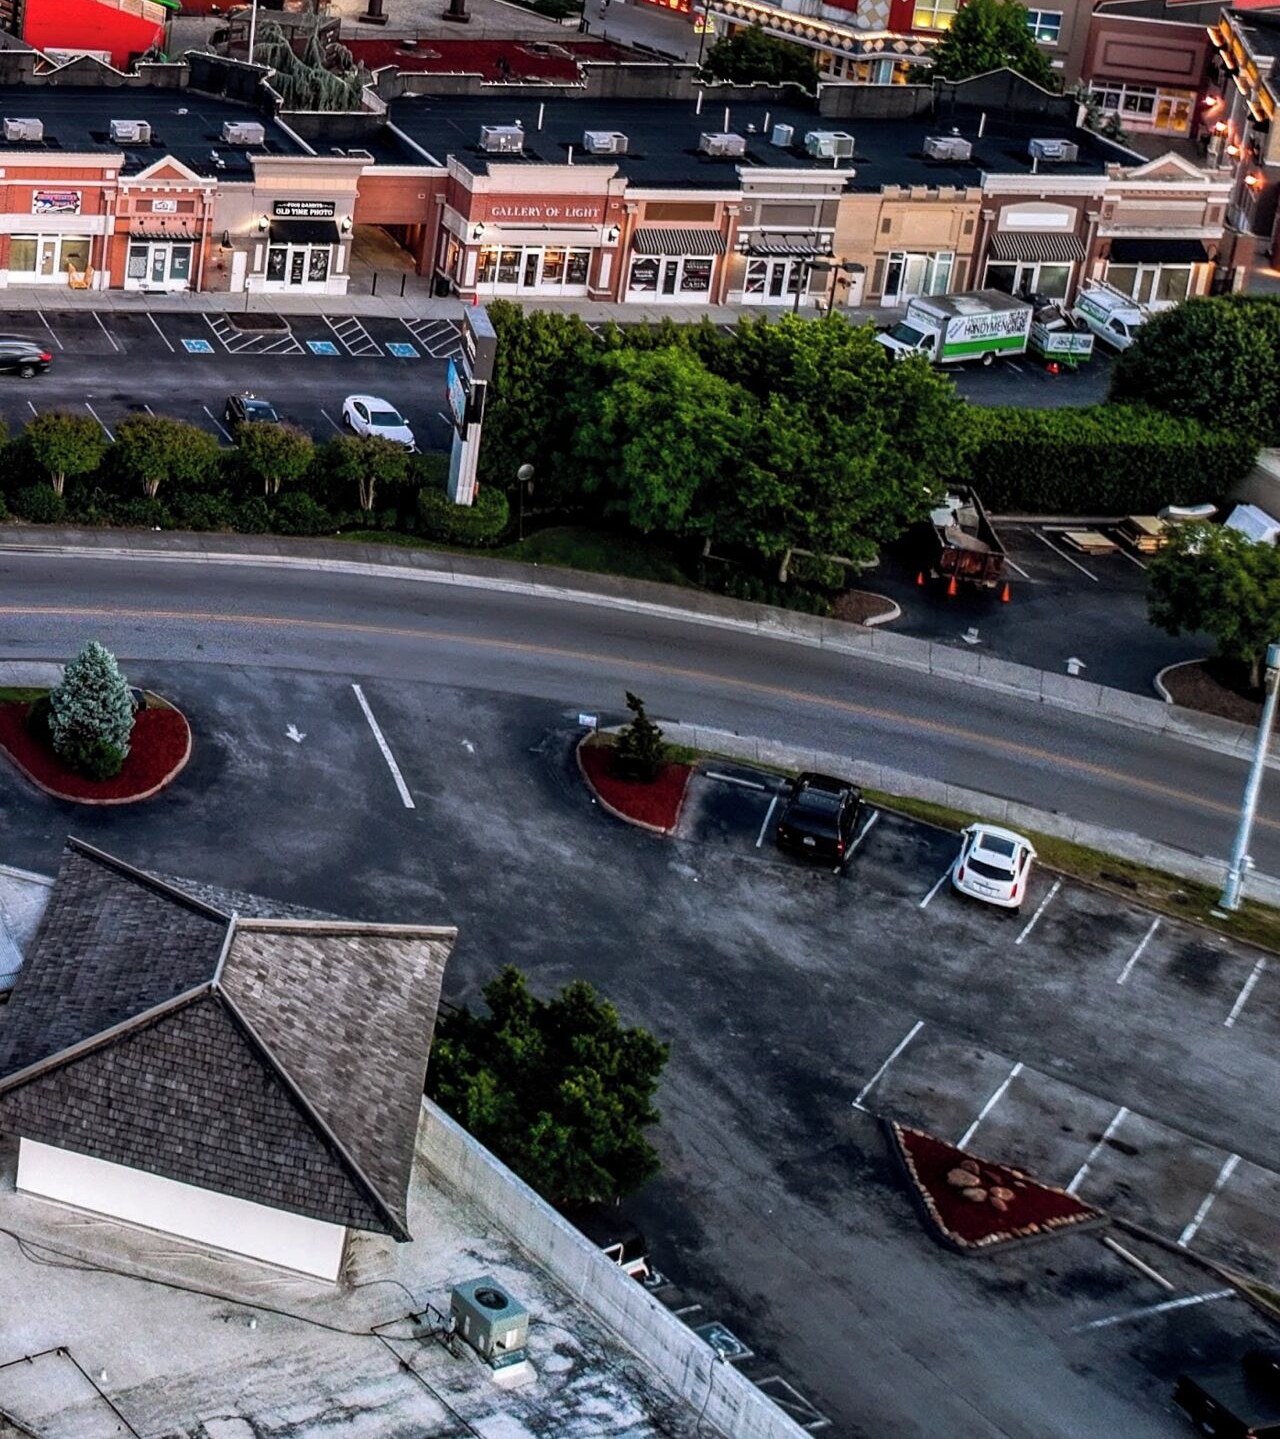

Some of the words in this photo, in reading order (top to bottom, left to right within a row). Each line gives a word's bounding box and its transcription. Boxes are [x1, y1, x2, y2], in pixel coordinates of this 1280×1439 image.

[291, 208, 309, 216] TIME
[309, 209, 333, 217] PHOTO
[491, 206, 542, 217] GALLERY
[546, 207, 561, 217] OF
[565, 207, 600, 218] LIGHT
